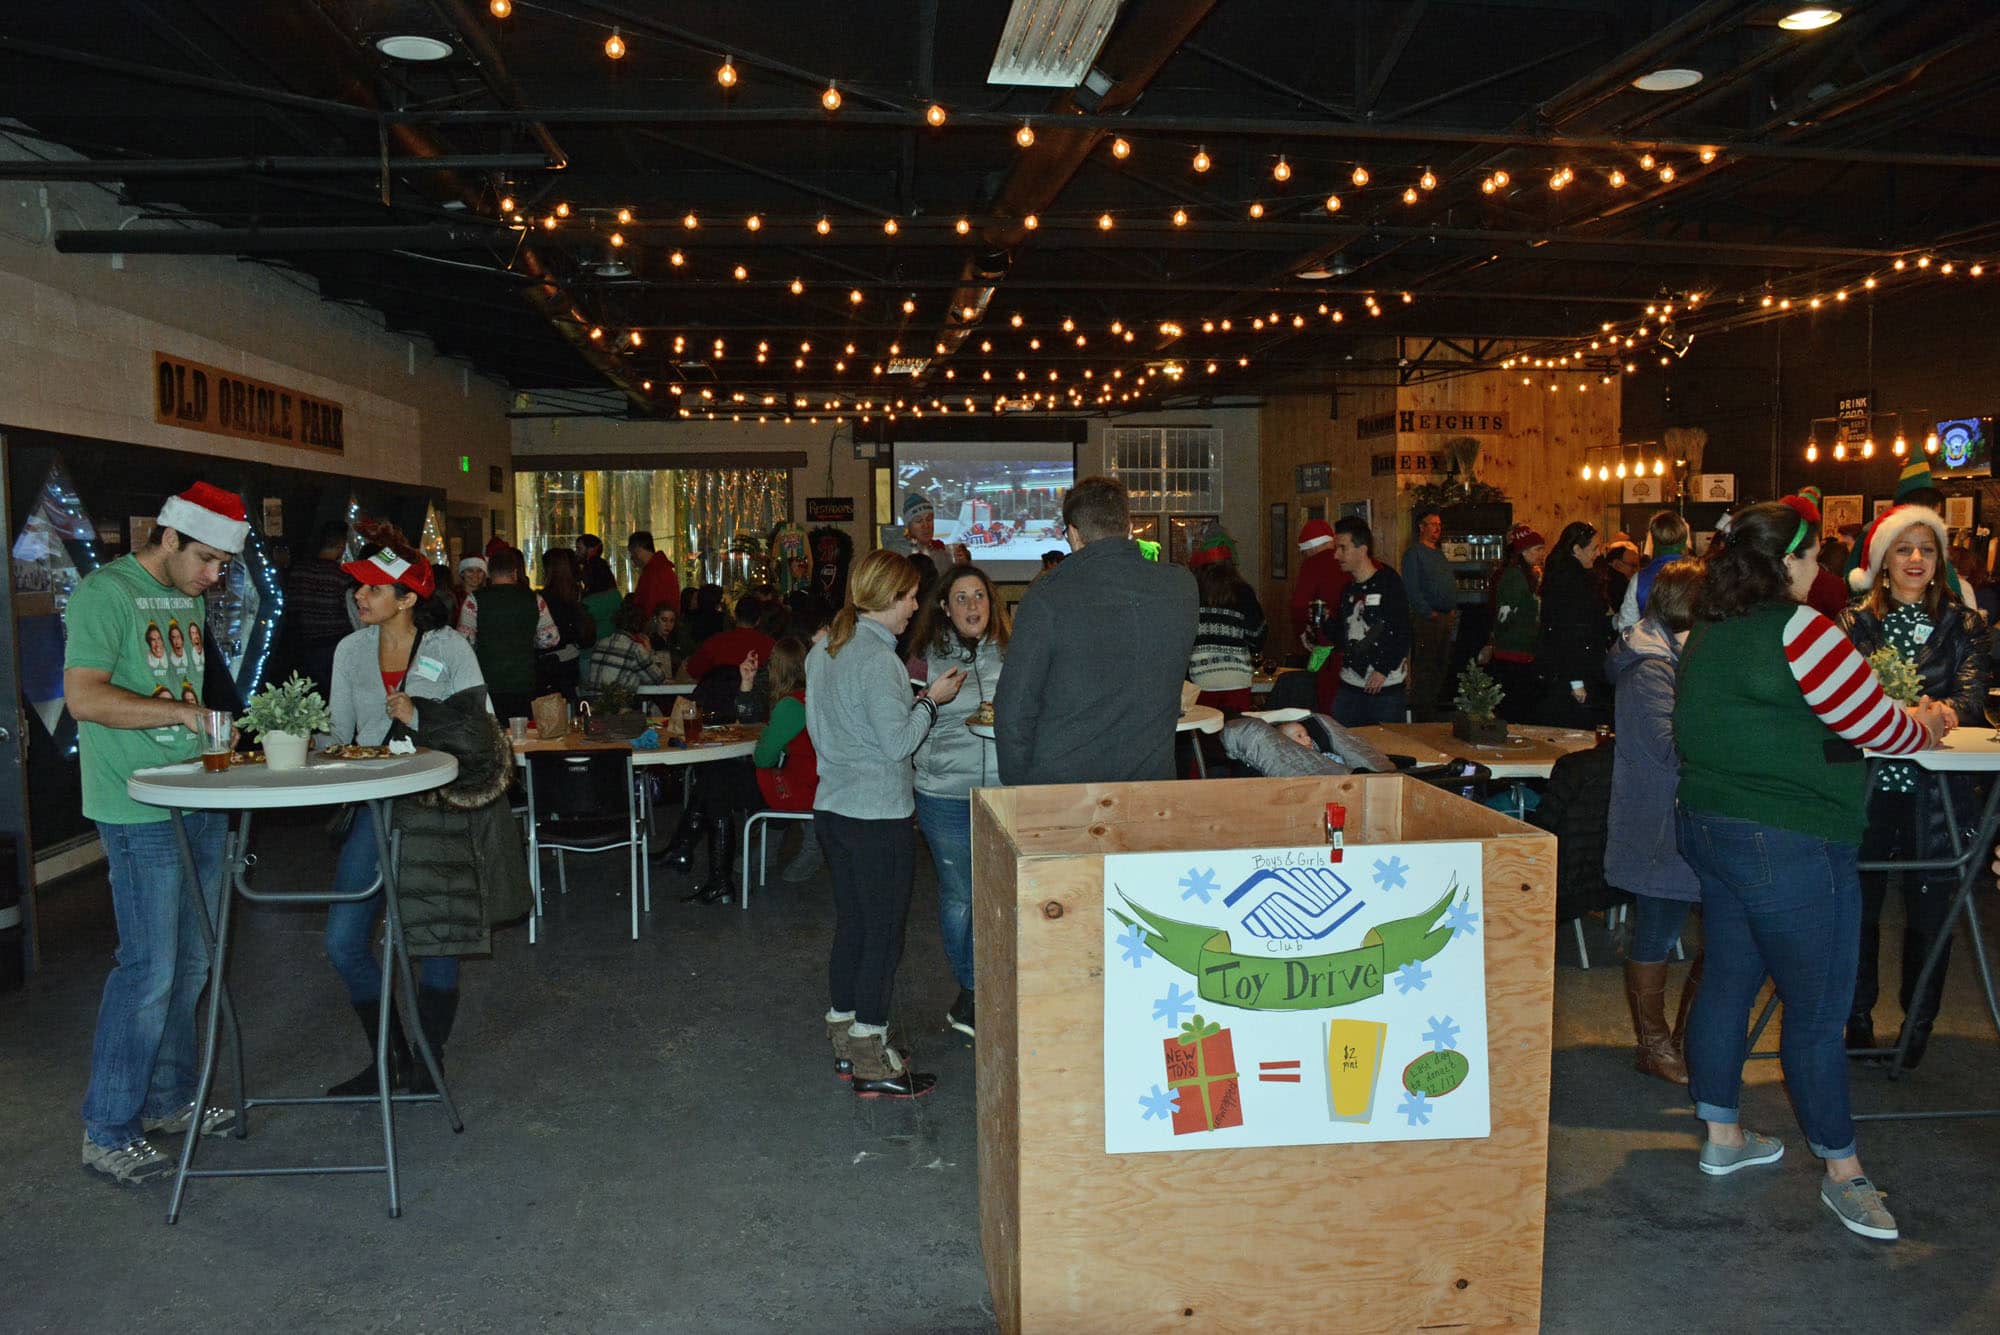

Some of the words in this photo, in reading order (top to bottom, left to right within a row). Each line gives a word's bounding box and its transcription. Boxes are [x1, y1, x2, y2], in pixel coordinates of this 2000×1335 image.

[160, 361, 208, 422] OLD
[219, 377, 292, 439] ORIOLE
[300, 398, 343, 450] PARK
[1839, 398, 1867, 409] DRINK
[1399, 411, 1503, 433] HEIGHTS
[1252, 854, 1281, 870] Boys
[1285, 851, 1294, 865] &
[1297, 851, 1325, 866] Girls
[1266, 940, 1303, 952] Club
[1205, 961, 1270, 1005] Toy
[1283, 960, 1380, 1001] Drive
[1166, 1046, 1196, 1063] NEW
[1343, 1044, 1358, 1060] $2
[1168, 1062, 1196, 1078] TOYS
[1343, 1060, 1358, 1072] pint
